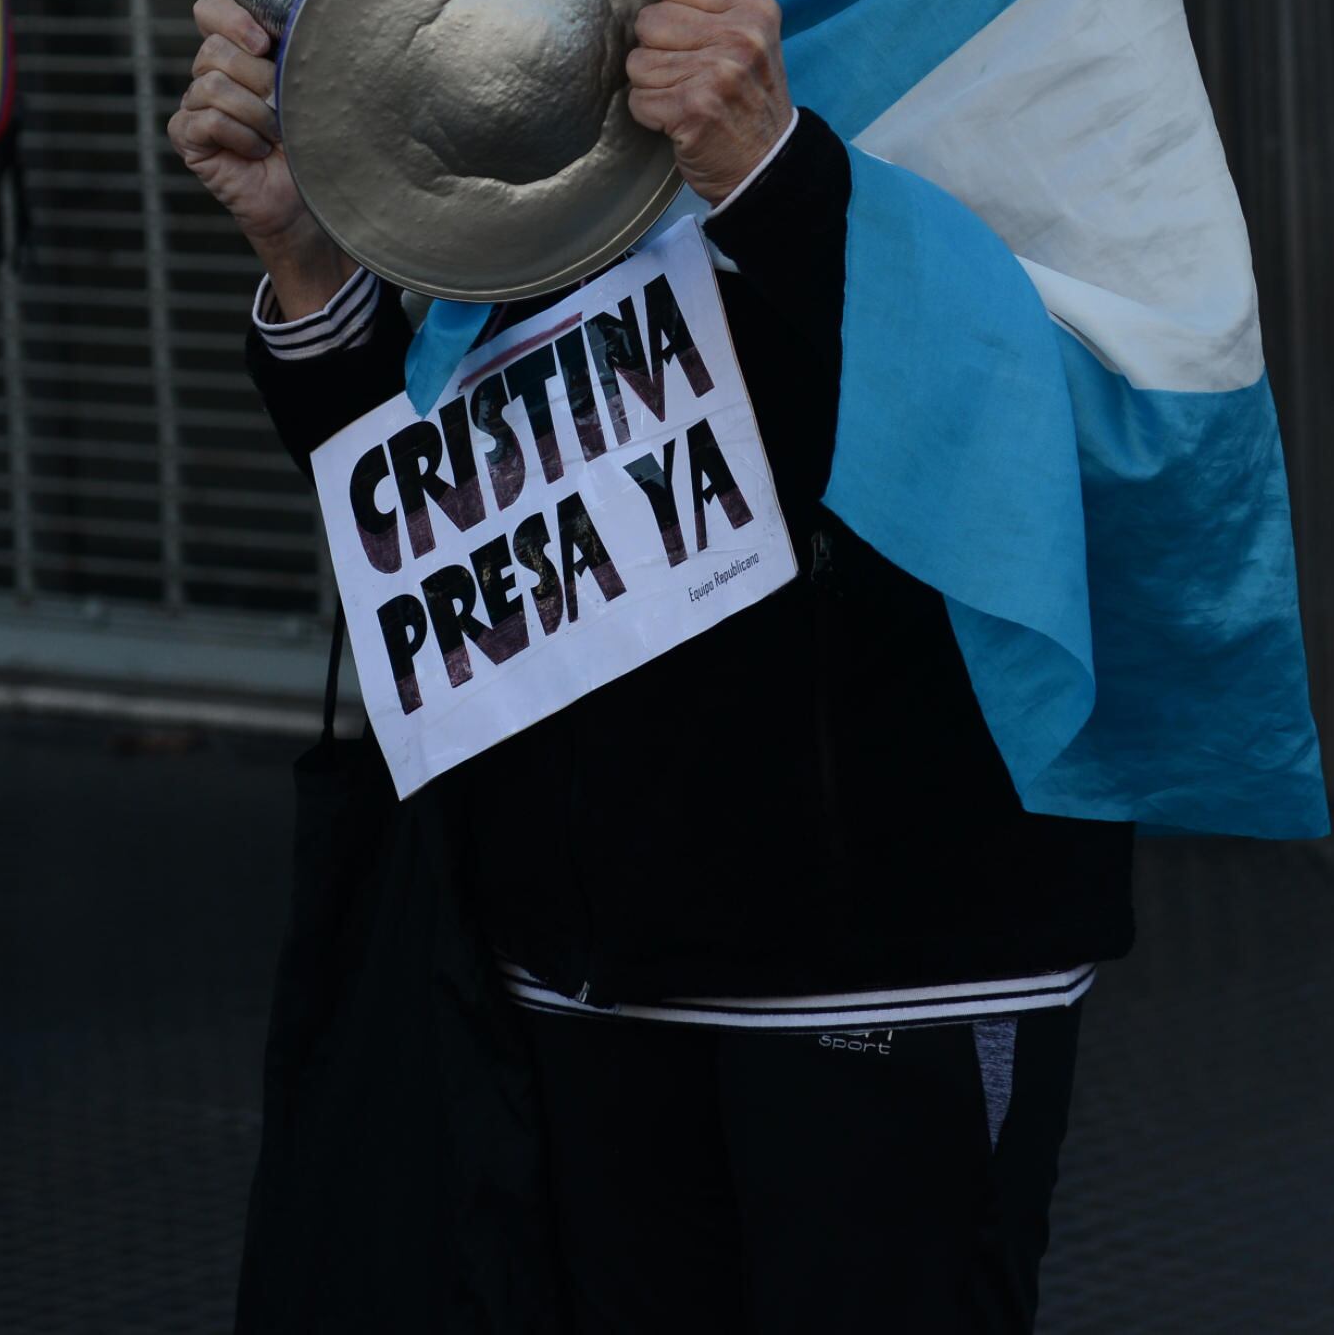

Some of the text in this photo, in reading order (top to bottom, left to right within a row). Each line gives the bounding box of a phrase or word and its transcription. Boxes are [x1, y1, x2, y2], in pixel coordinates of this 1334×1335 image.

[350, 273, 715, 575] CRISTINA
[377, 418, 754, 715] PRESA YA
[688, 552, 760, 602] Equipo Republicano
